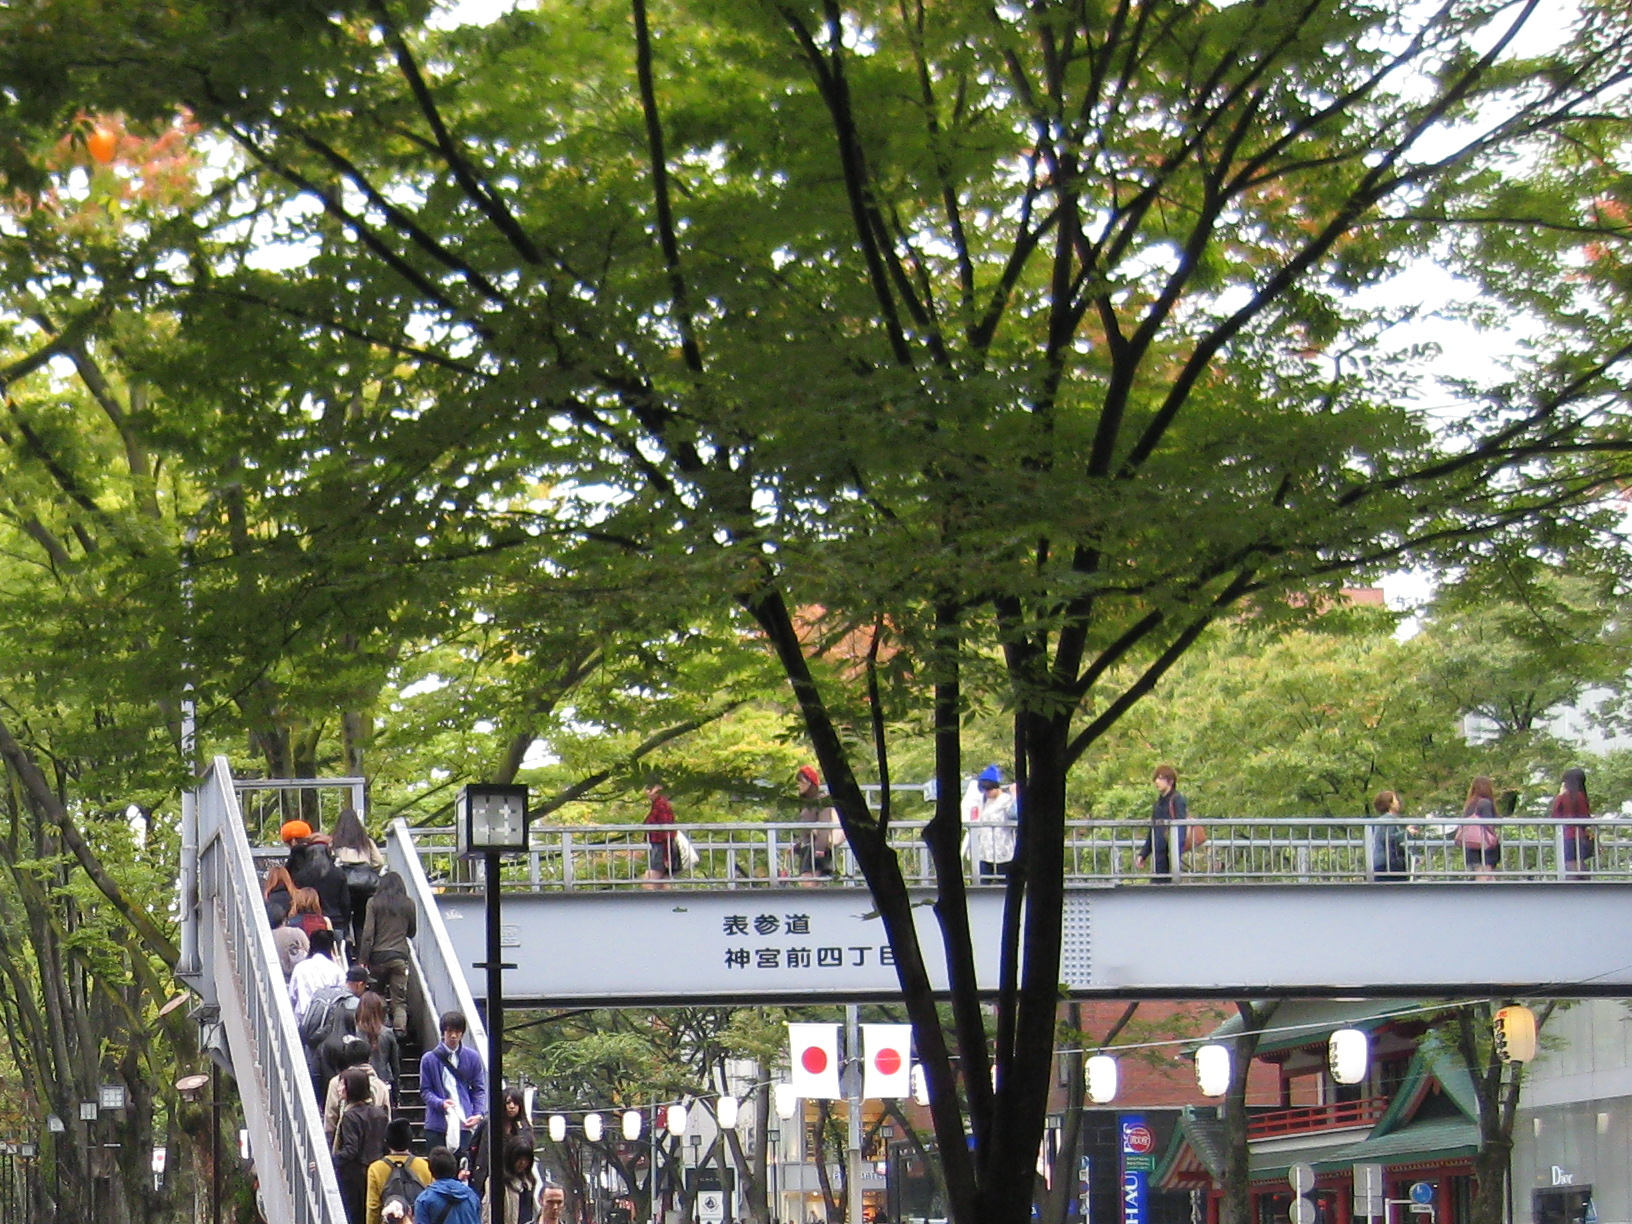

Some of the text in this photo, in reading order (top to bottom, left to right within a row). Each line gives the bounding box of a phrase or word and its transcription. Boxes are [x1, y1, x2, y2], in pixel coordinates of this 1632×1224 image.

[723, 914, 810, 936] 表参道
[724, 946, 897, 969] 神宮前四丁目
